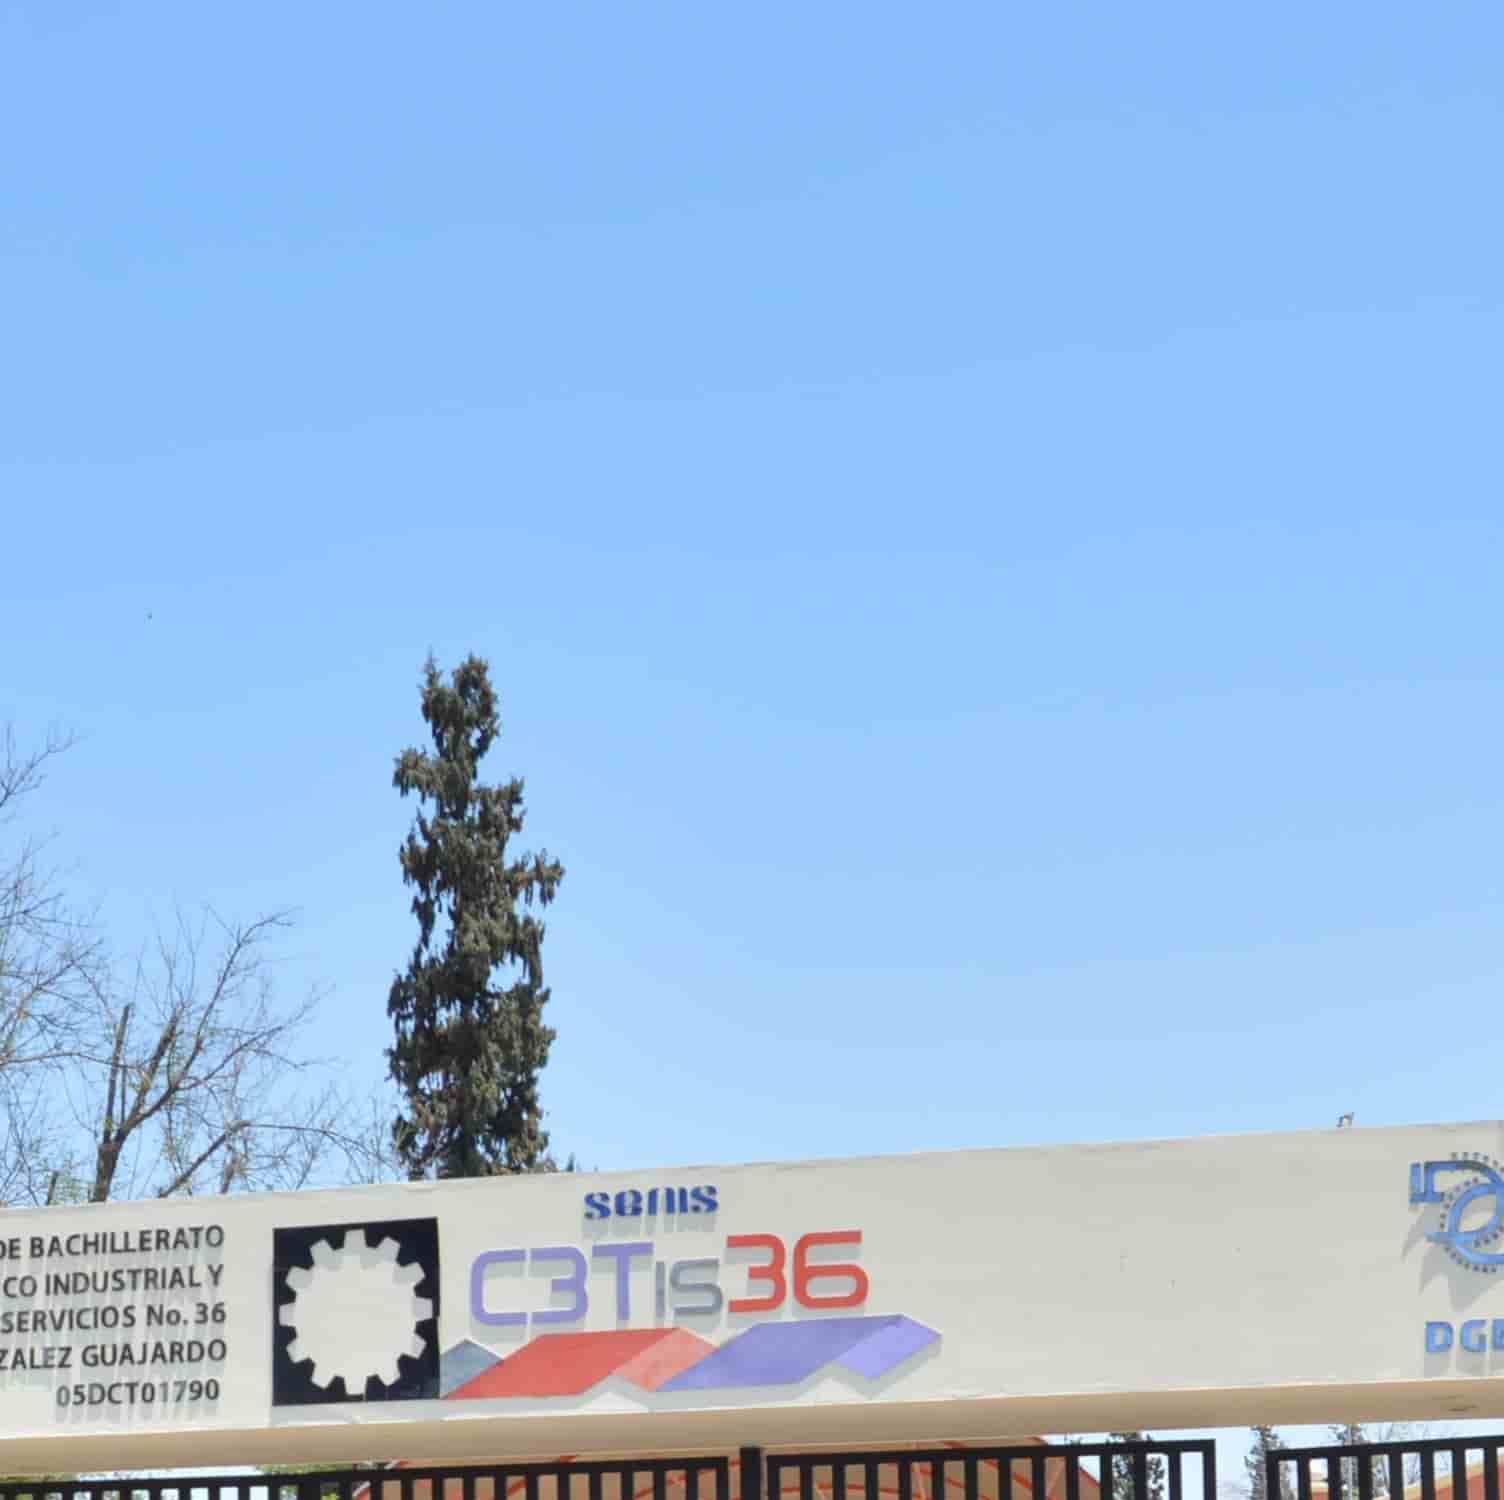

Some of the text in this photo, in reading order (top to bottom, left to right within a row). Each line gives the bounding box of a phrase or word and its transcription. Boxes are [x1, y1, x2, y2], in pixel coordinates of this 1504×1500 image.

[29, 1225, 225, 1259] BACHILLERATO
[46, 1266, 201, 1297] INDUSTRIAL
[208, 1264, 224, 1287] Y
[0, 1305, 137, 1335] SERVICIOS
[146, 1303, 188, 1327] No.
[194, 1302, 226, 1325] 36
[81, 1338, 227, 1368] GUAJARDO
[56, 1379, 220, 1408] 05DCT01790
